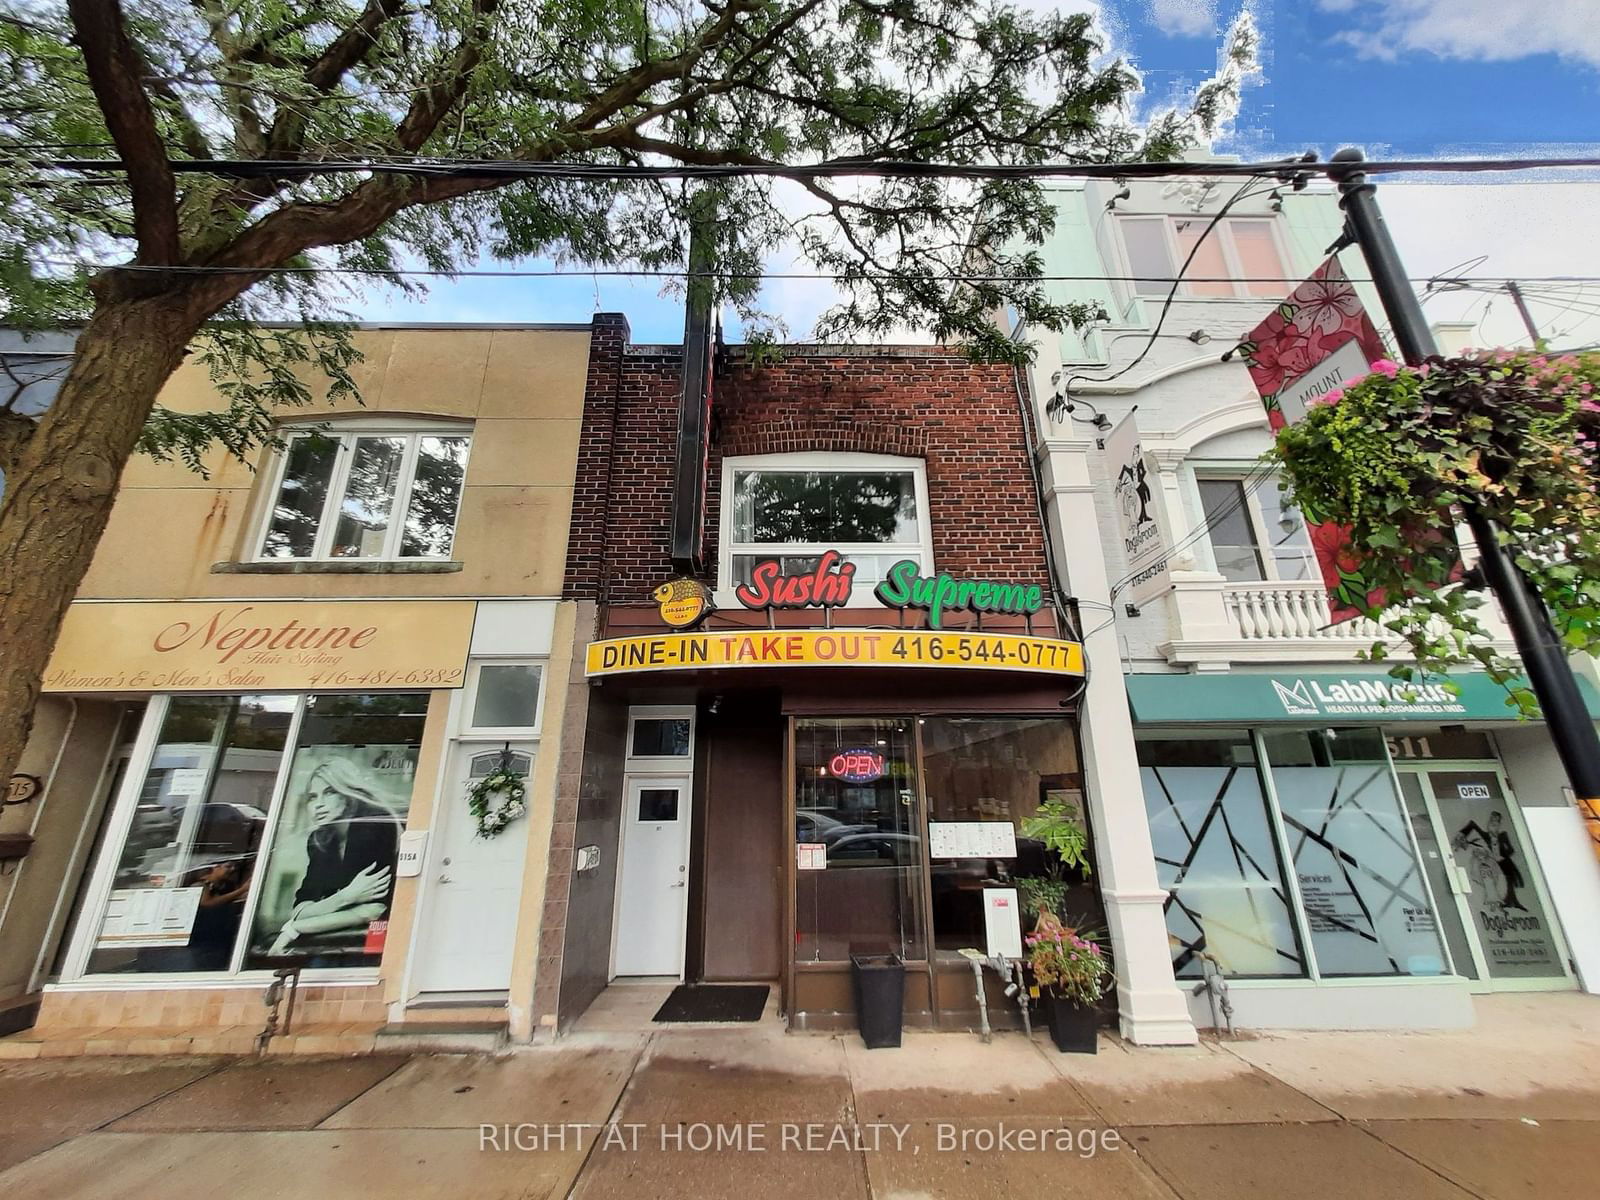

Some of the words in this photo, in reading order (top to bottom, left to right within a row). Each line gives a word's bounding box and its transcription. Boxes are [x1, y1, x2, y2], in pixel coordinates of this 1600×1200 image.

[1300, 367, 1344, 408] MOUNT
[737, 552, 856, 608] Sushi
[876, 560, 1043, 629] Supreme
[153, 607, 378, 663] Neptune
[602, 637, 708, 670] DINE-IN
[719, 636, 804, 664] TAKE
[814, 635, 882, 662] OUT
[891, 635, 1070, 670] 416-544-0777
[243, 650, 283, 665] Hair
[293, 650, 344, 666] Styling
[47, 669, 124, 688] Women's
[128, 671, 149, 687] &
[151, 669, 211, 687] Men's
[216, 667, 266, 686] Salon
[307, 668, 463, 686] 416-481-6382
[831, 755, 883, 775] OPEN
[1461, 787, 1487, 797] OPEN
